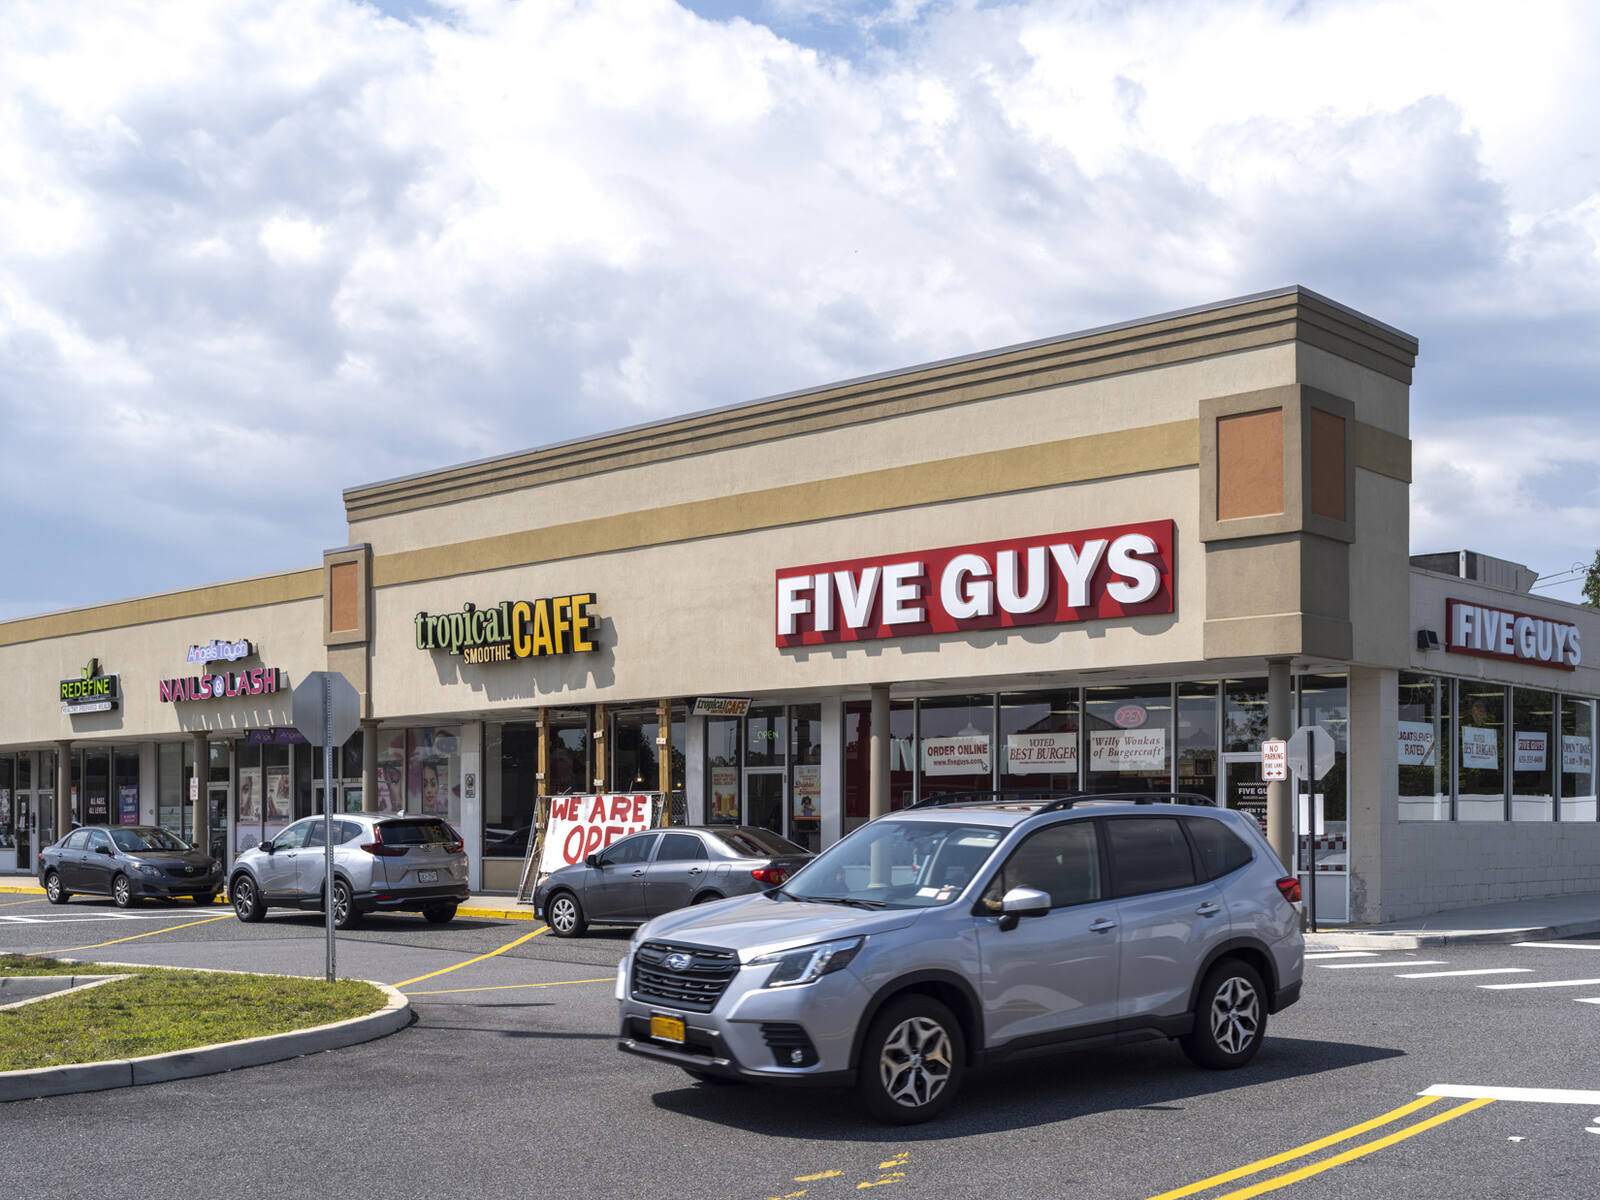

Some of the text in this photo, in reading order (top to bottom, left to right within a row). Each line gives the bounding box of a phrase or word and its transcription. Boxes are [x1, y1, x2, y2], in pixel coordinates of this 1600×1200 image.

[777, 533, 1160, 635] FIVE GUYS
[415, 593, 596, 658] tropical CAFE
[1452, 604, 1582, 666] FIVE GUYS
[463, 644, 511, 664] SMOOTHIE
[61, 678, 110, 699] REDEFINE
[160, 674, 212, 702] NAILS
[225, 668, 276, 697] LASH
[724, 700, 748, 714] CAFE
[1115, 709, 1145, 722] OPEN
[757, 730, 779, 740] OPEN
[1029, 738, 1055, 747] VOTED
[927, 744, 988, 757] ORDER ONLINE
[1009, 746, 1076, 760] BEST BURGER
[1093, 747, 1104, 759] of
[1405, 744, 1425, 756] RATED
[1238, 787, 1268, 795] FIVE GU
[552, 795, 647, 823] WE ARE
[563, 825, 647, 865] OPE
